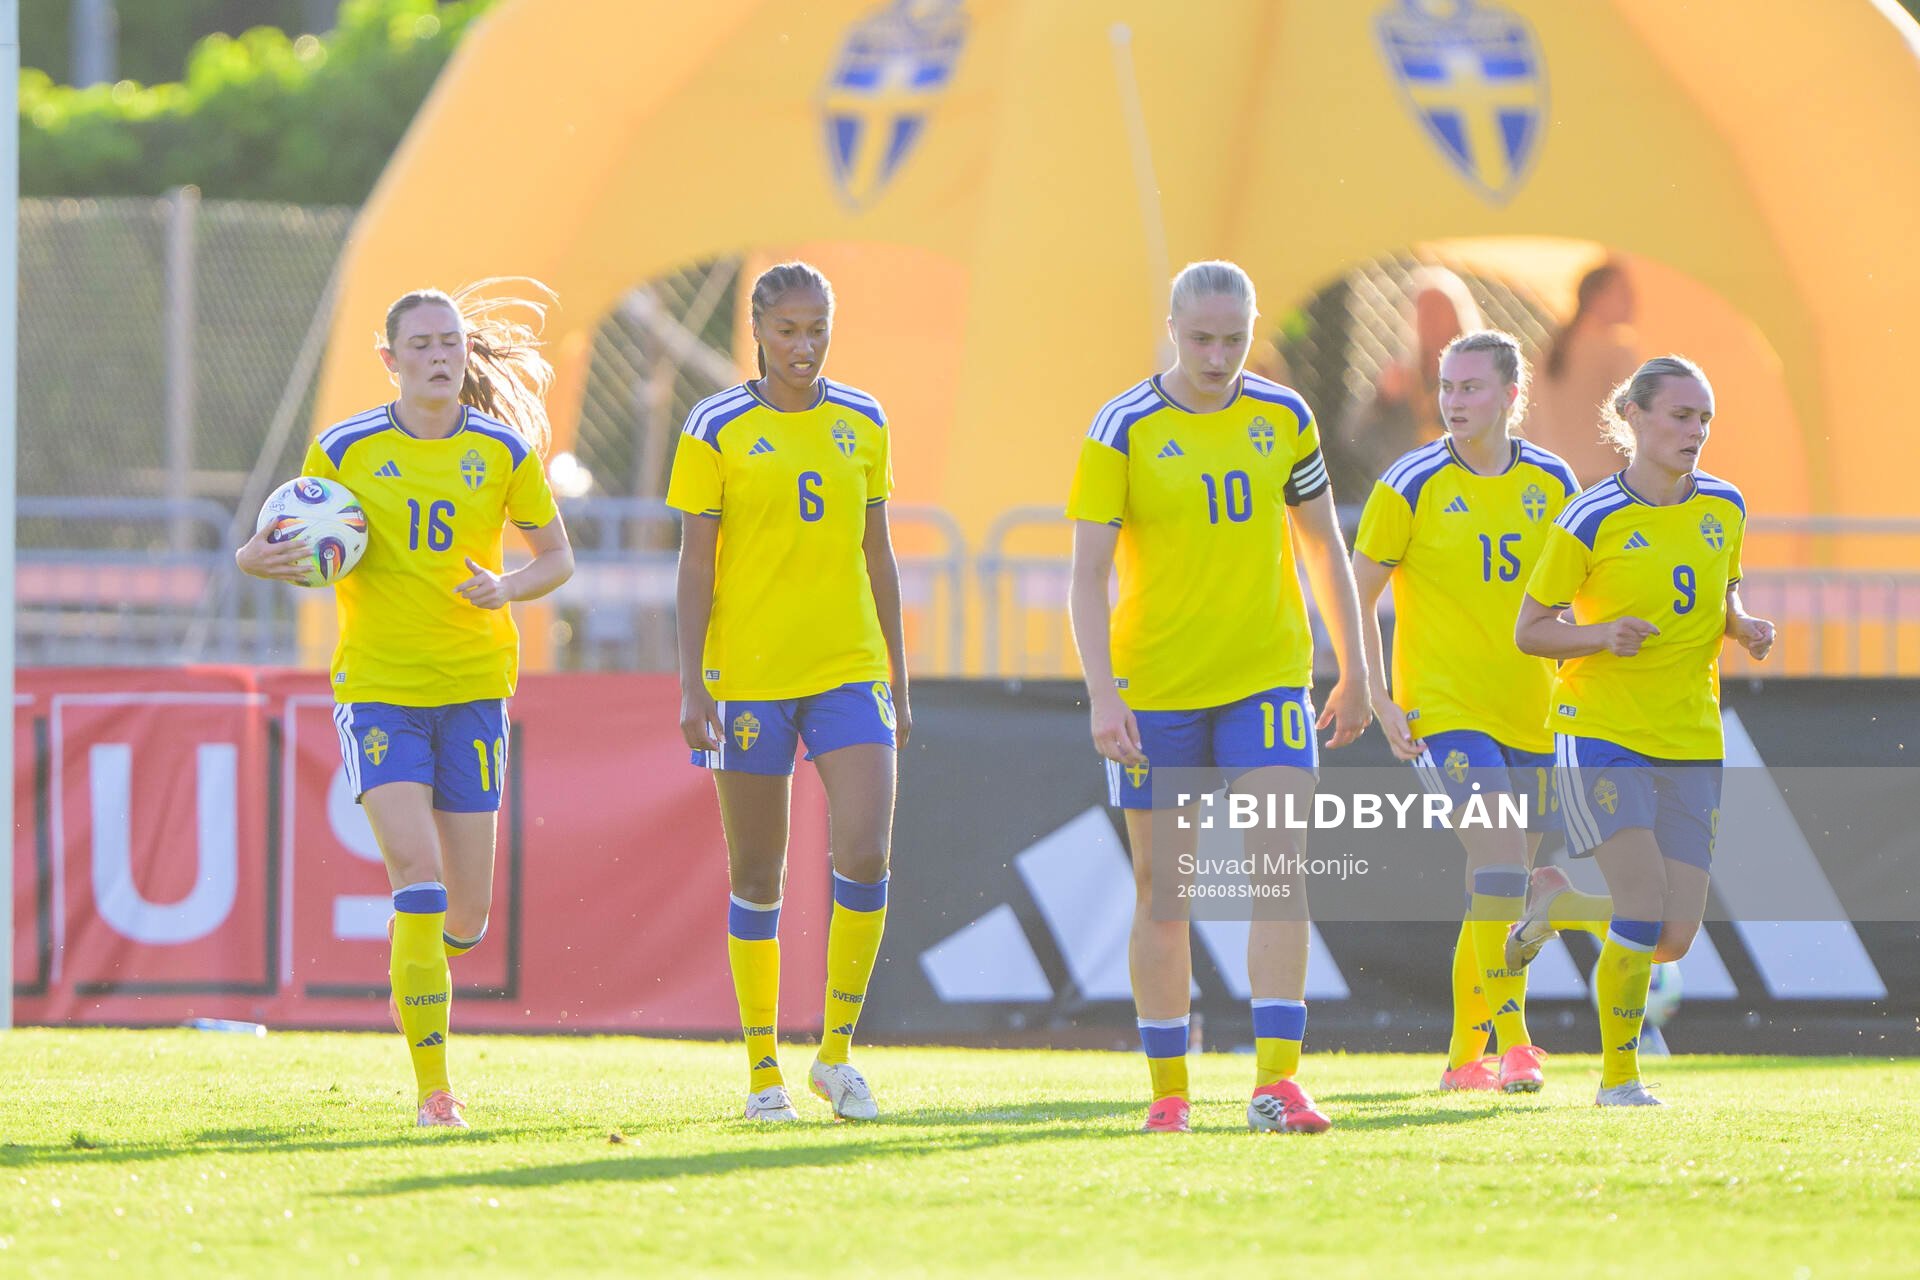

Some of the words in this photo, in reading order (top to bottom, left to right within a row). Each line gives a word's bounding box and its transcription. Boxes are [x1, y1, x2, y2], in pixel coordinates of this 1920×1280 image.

[798, 471, 825, 522] 6
[1201, 469, 1253, 525] 10
[407, 498, 456, 552] 16
[1479, 533, 1522, 582] 15
[1672, 564, 1697, 616] 9
[872, 682, 896, 730] 6
[1260, 701, 1306, 750] 10
[405, 992, 447, 1006] SVERIGE
